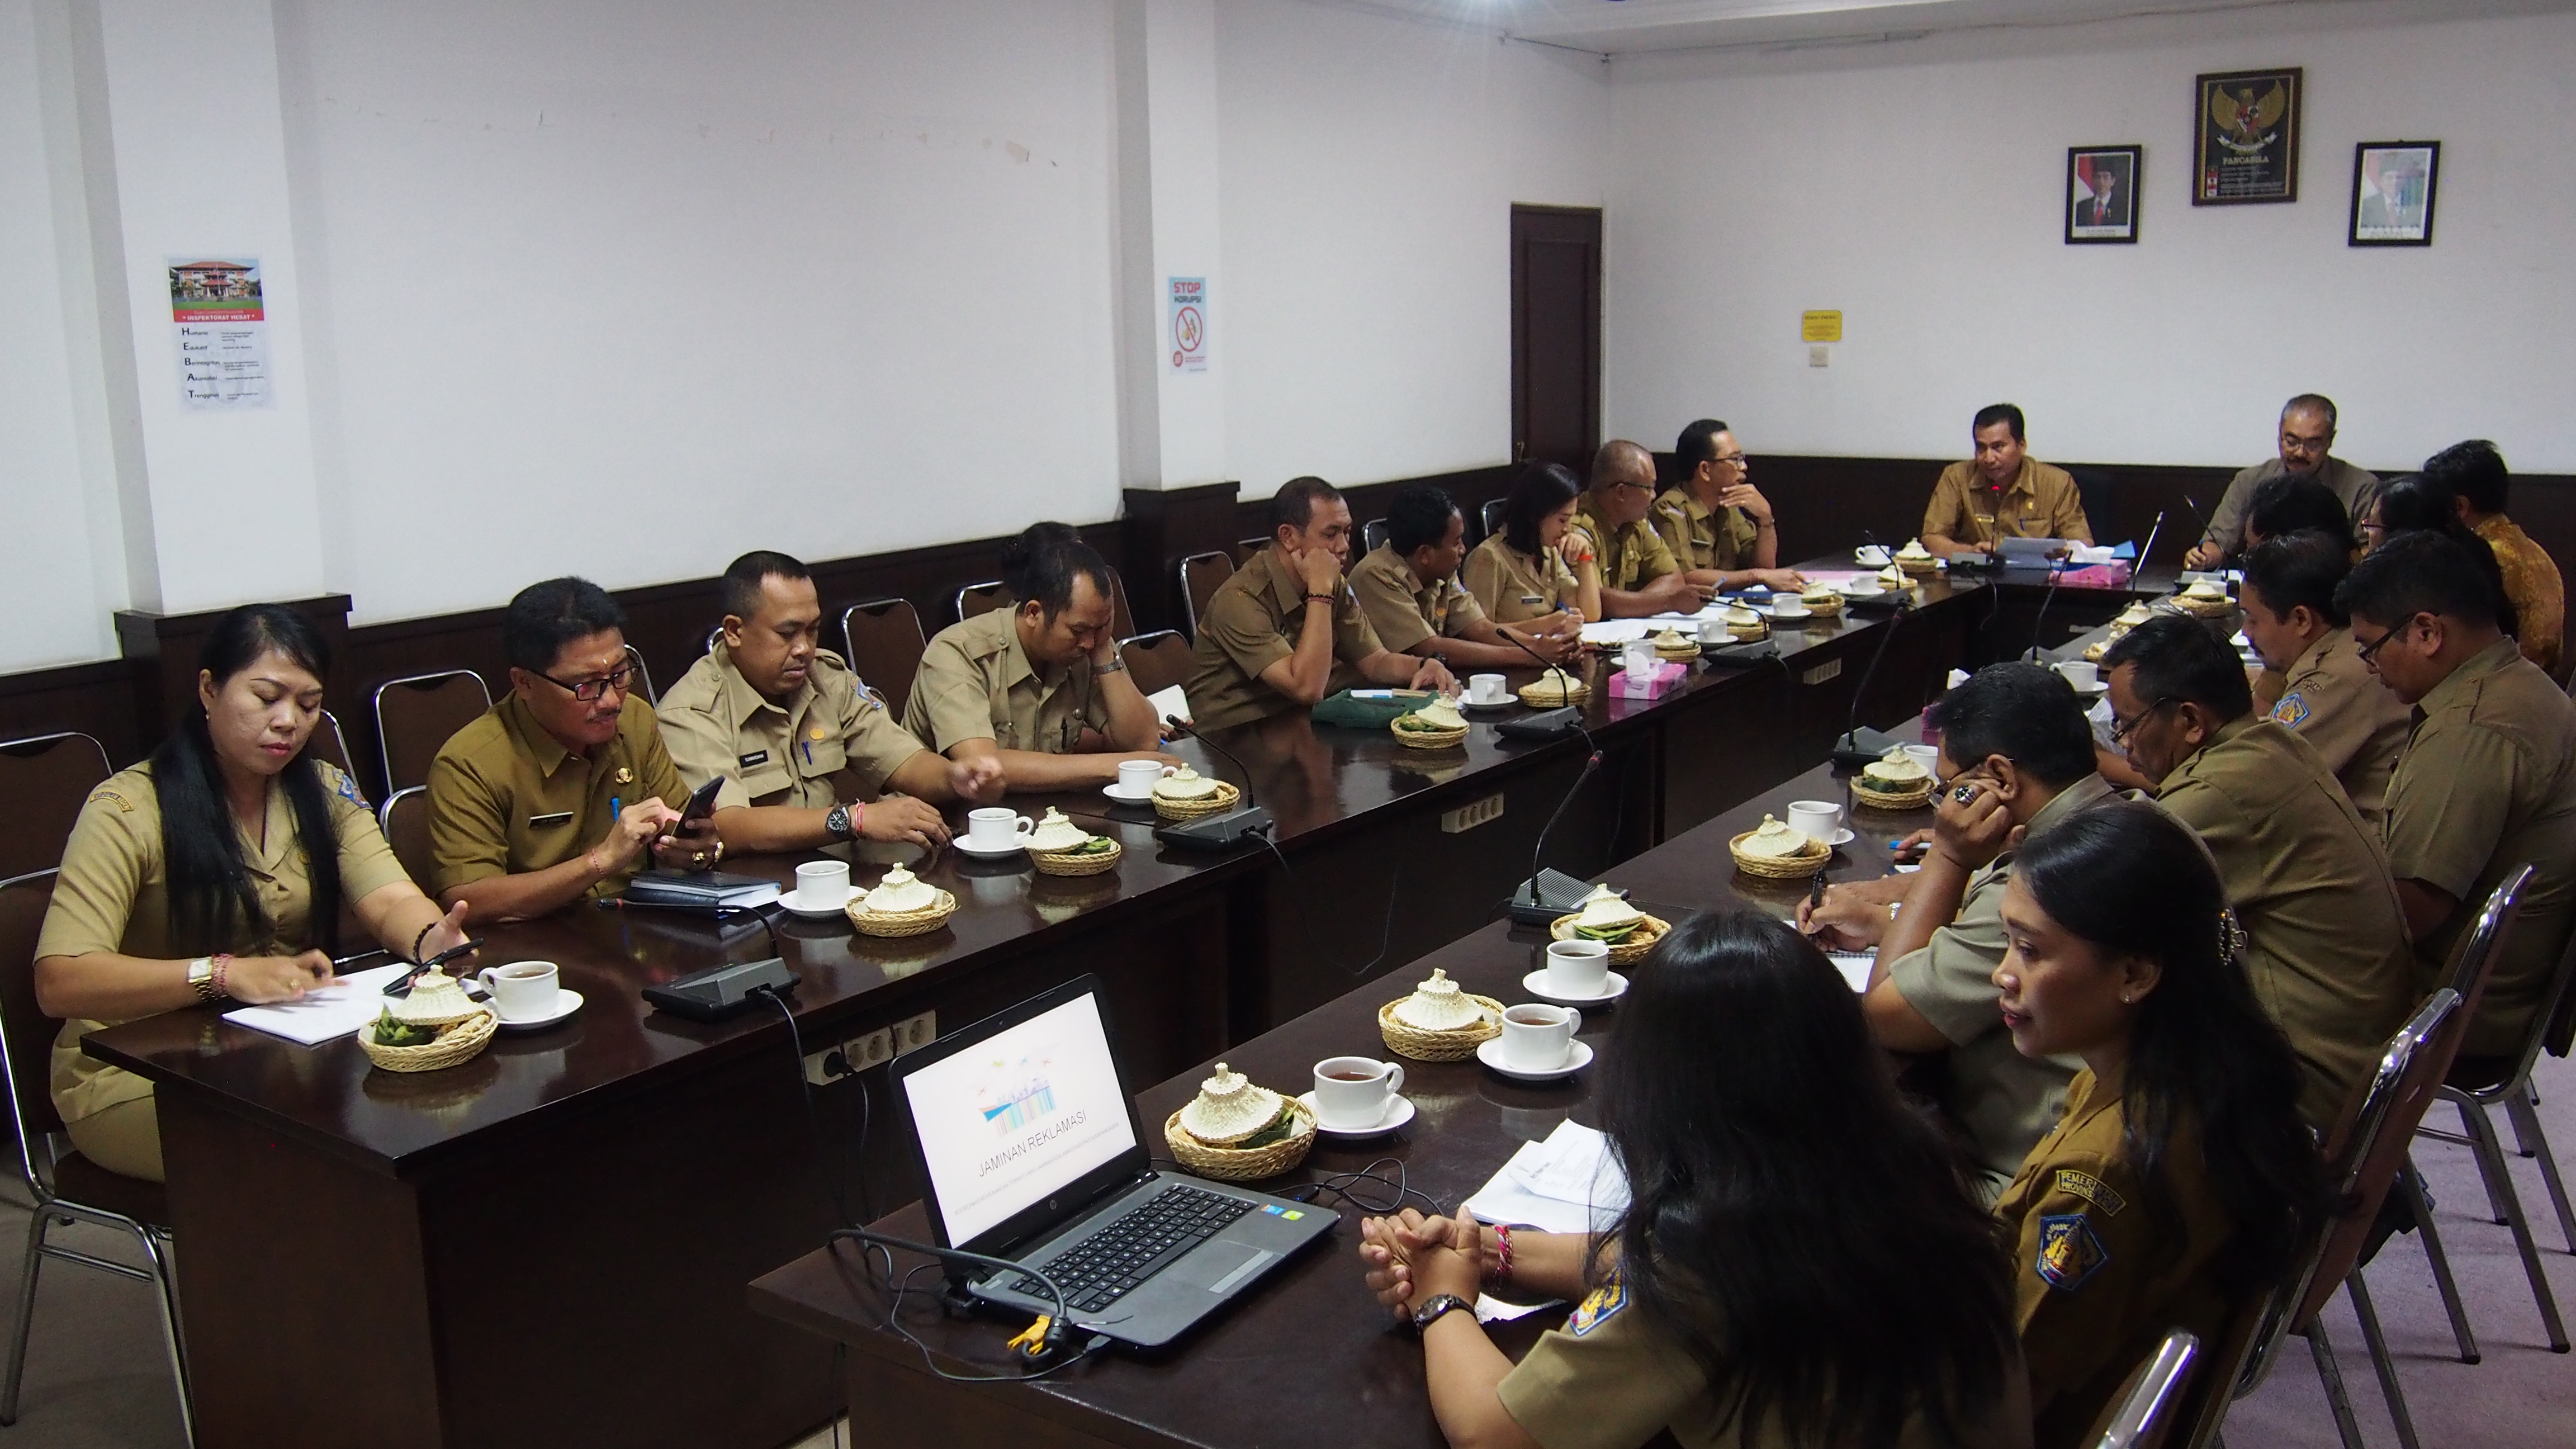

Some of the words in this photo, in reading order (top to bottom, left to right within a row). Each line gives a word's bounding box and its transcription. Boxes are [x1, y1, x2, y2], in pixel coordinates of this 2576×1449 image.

[1173, 282, 1201, 293] STOP
[979, 1143, 1026, 1177] JAMINAN
[1026, 1109, 1087, 1151] REKLAMASI
[981, 1182, 1009, 1201] KEWENANGAN
[1073, 1135, 1095, 1150] KABUPATEN
